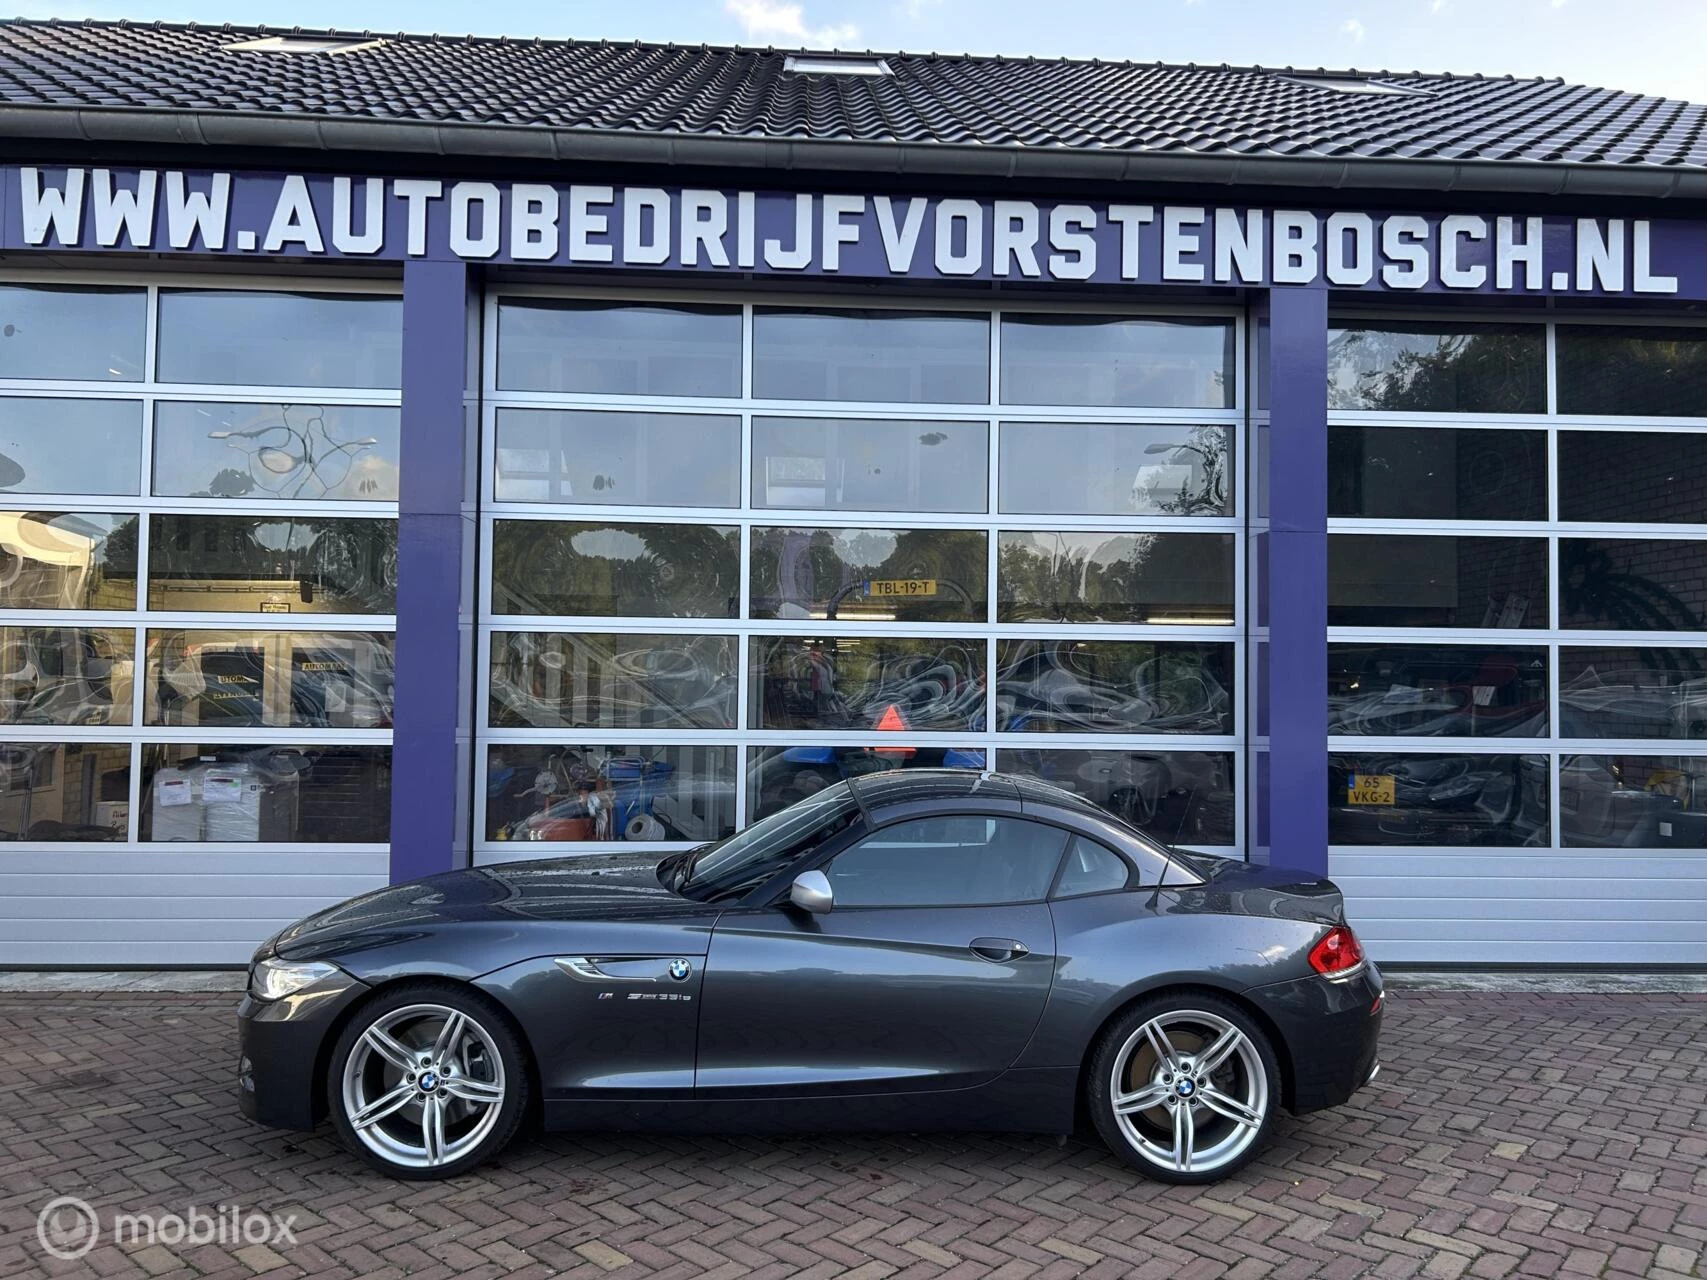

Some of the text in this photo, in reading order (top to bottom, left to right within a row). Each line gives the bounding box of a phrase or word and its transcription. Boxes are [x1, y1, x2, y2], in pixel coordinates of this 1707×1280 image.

[20, 167, 1679, 293] WWW.AUTOBEDRIJFVORSTENBOSCH.NL
[876, 581, 930, 595] TBL-19-T
[1363, 776, 1381, 789] 65
[1352, 790, 1391, 803] VKG-2
